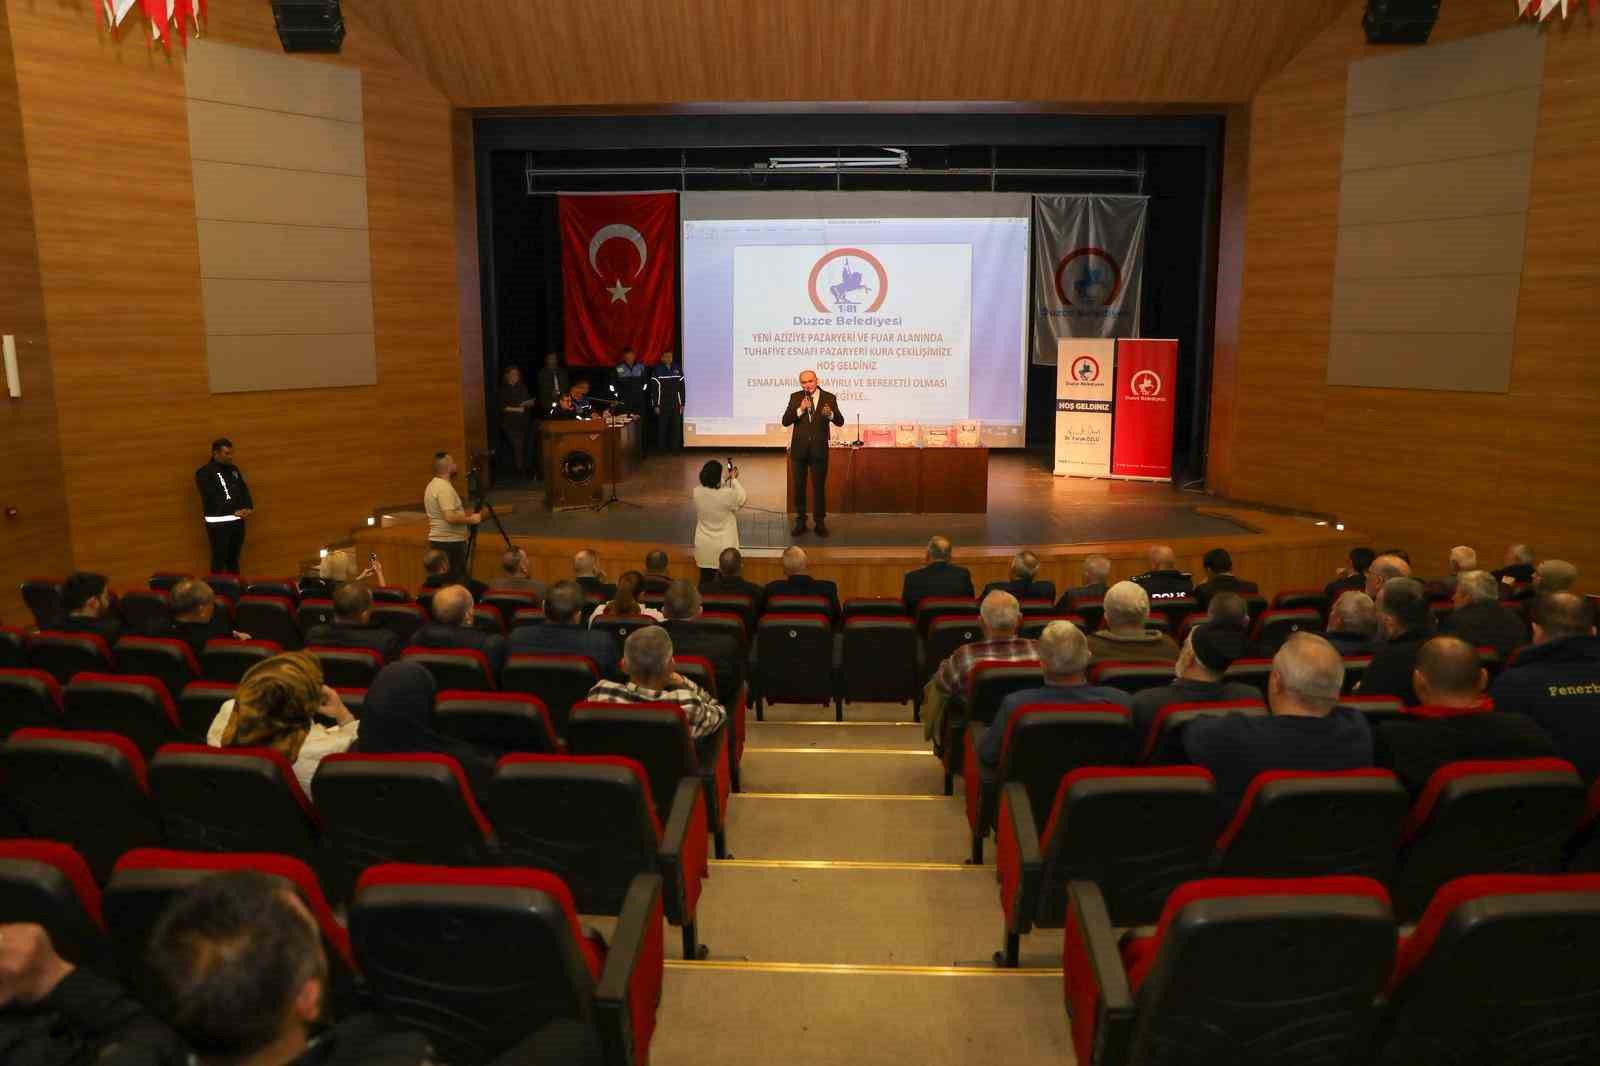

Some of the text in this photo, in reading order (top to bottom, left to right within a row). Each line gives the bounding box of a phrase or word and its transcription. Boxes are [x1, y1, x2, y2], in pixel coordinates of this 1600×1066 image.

[836, 315, 903, 328] Belediyesi
[751, 331, 773, 343] YENİ
[808, 331, 856, 343] PAZARYERİ
[857, 332, 870, 343] VE
[871, 332, 896, 343] FUAR
[870, 346, 895, 357] KURA
[836, 360, 878, 371] GELDİNİZ
[1058, 402, 1110, 411] HOŞ GELDİNİZ
